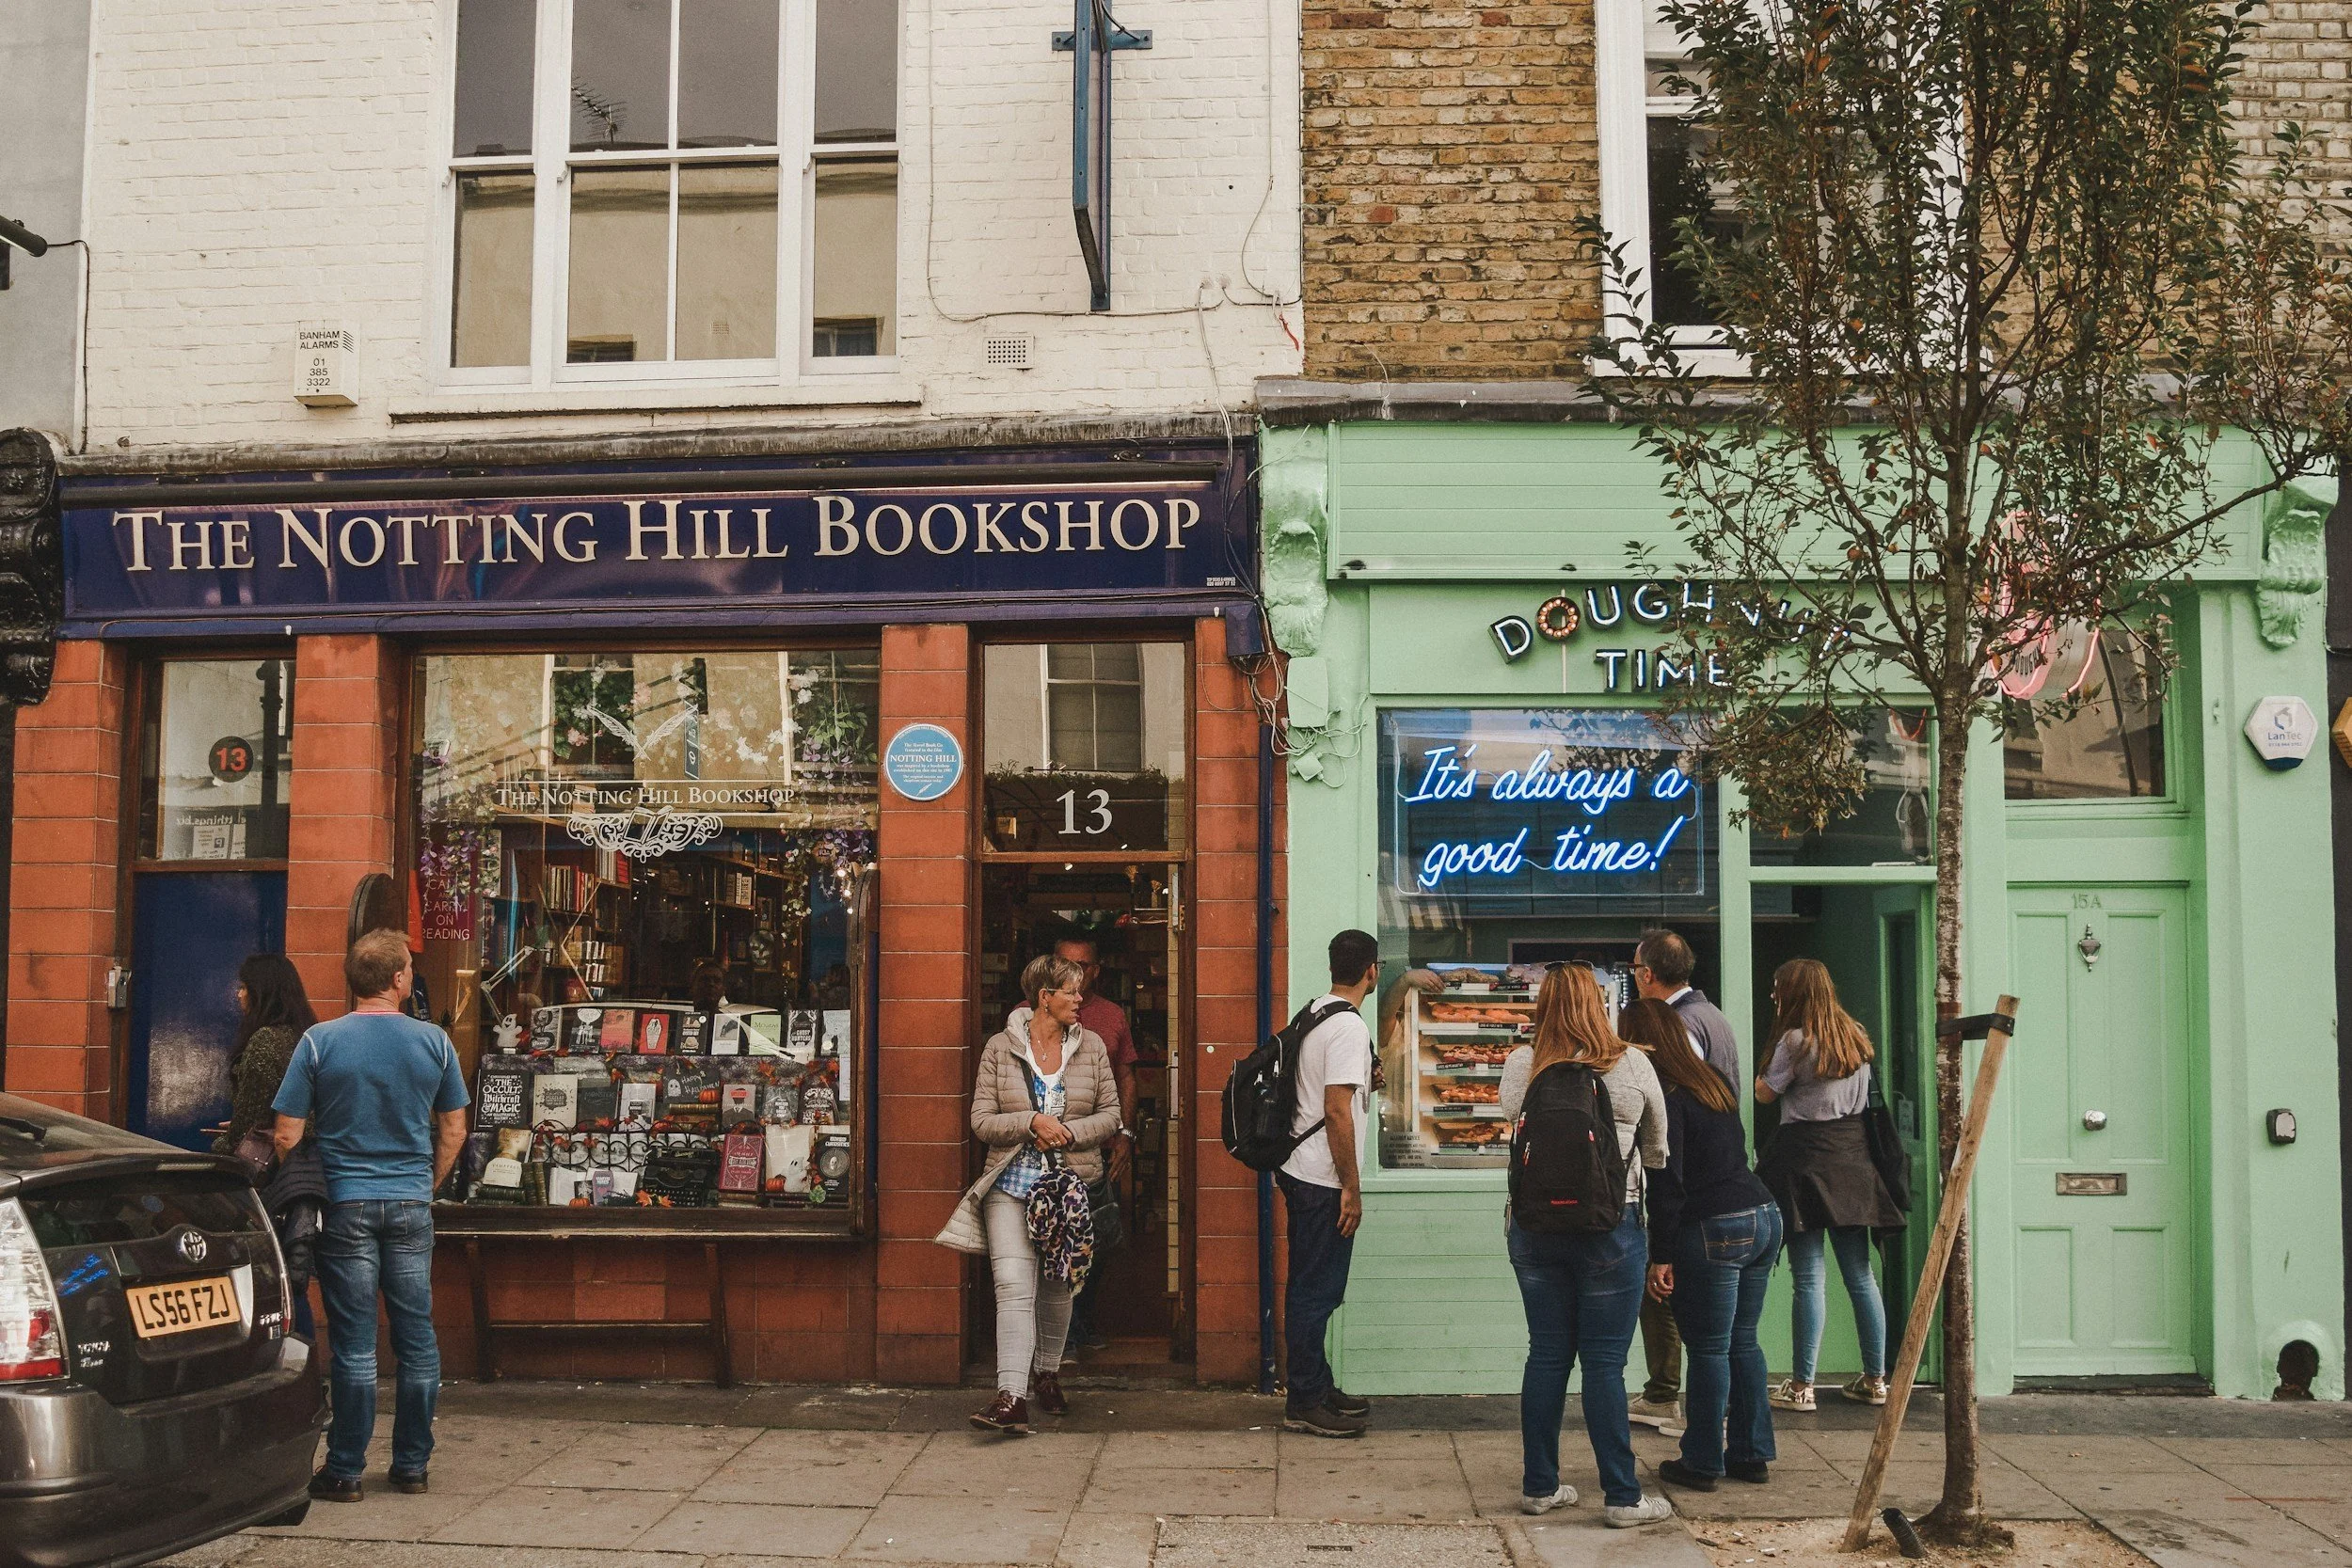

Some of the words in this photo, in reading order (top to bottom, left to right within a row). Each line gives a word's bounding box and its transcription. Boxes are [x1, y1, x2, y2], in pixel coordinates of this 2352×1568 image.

[299, 330, 341, 340] BANHAM
[300, 341, 339, 349] ALARMS
[313, 357, 326, 366] 01
[310, 368, 328, 376] 385
[307, 377, 330, 387] 3322
[113, 509, 255, 571] THE
[275, 507, 598, 569] NOTTING
[623, 499, 788, 562] HILL
[814, 495, 1200, 557] BOOKSHOP
[1594, 649, 1733, 691] TIME
[215, 747, 247, 772] 13
[890, 754, 932, 763] NOTTING
[935, 754, 957, 763] HILL
[1405, 743, 1477, 803] It's
[1491, 749, 1634, 816] always
[1653, 767, 1692, 801] a
[496, 788, 537, 806] THE
[542, 787, 632, 805] NOTTING
[638, 786, 683, 804] HILL
[688, 786, 796, 804] BOOKSHOP
[1056, 788, 1113, 837] 13
[1419, 827, 1528, 888] good
[1552, 816, 1685, 873] time!
[2072, 893, 2102, 909] 15A
[436, 914, 454, 926] ON
[484, 1093, 520, 1103] Witchcraft
[490, 1103, 521, 1113] MAGIC
[135, 1290, 191, 1330] LS56
[190, 1284, 230, 1323] FZJ
